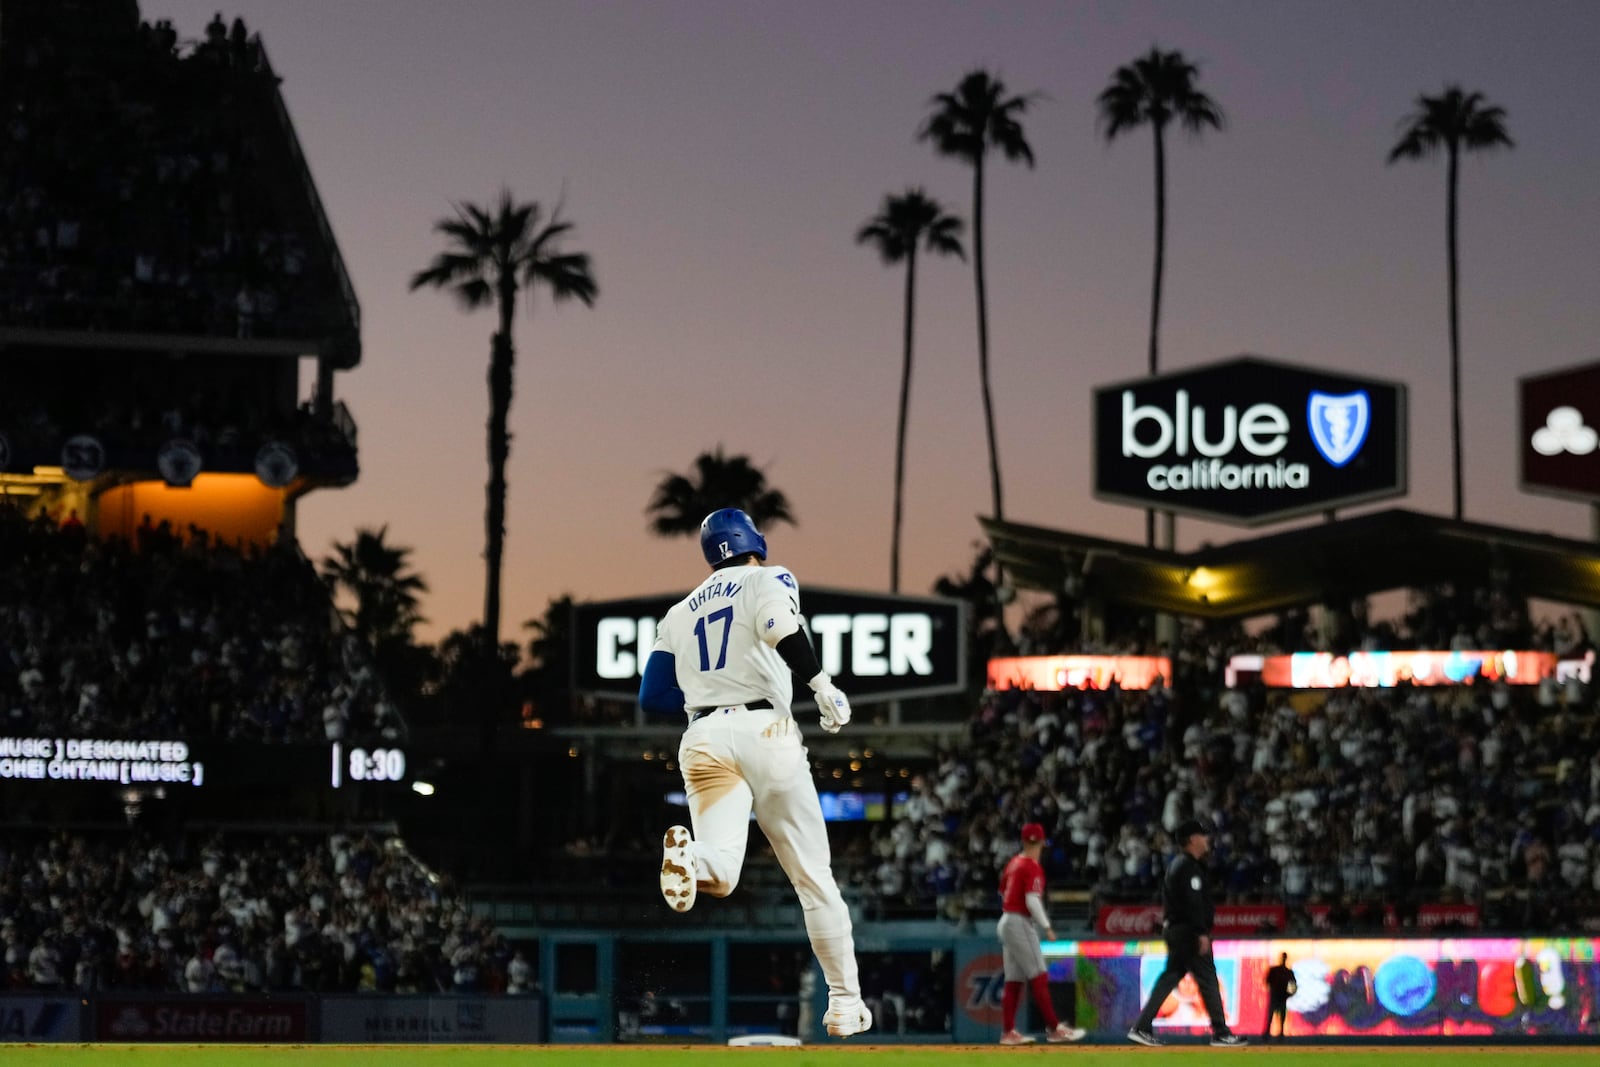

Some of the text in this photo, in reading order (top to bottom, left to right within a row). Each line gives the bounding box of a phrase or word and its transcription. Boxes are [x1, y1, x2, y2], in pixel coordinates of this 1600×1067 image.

[1122, 389, 1290, 458] blue
[1147, 458, 1310, 491] california
[718, 541, 728, 553] 17
[689, 581, 743, 612] OHTANI
[694, 605, 734, 672] 17
[67, 740, 188, 761] DESIGNATED
[349, 748, 406, 781] 8:30
[48, 760, 119, 780] OHTANI
[131, 762, 190, 782] MUSIC
[365, 1017, 453, 1033] MERRILL
